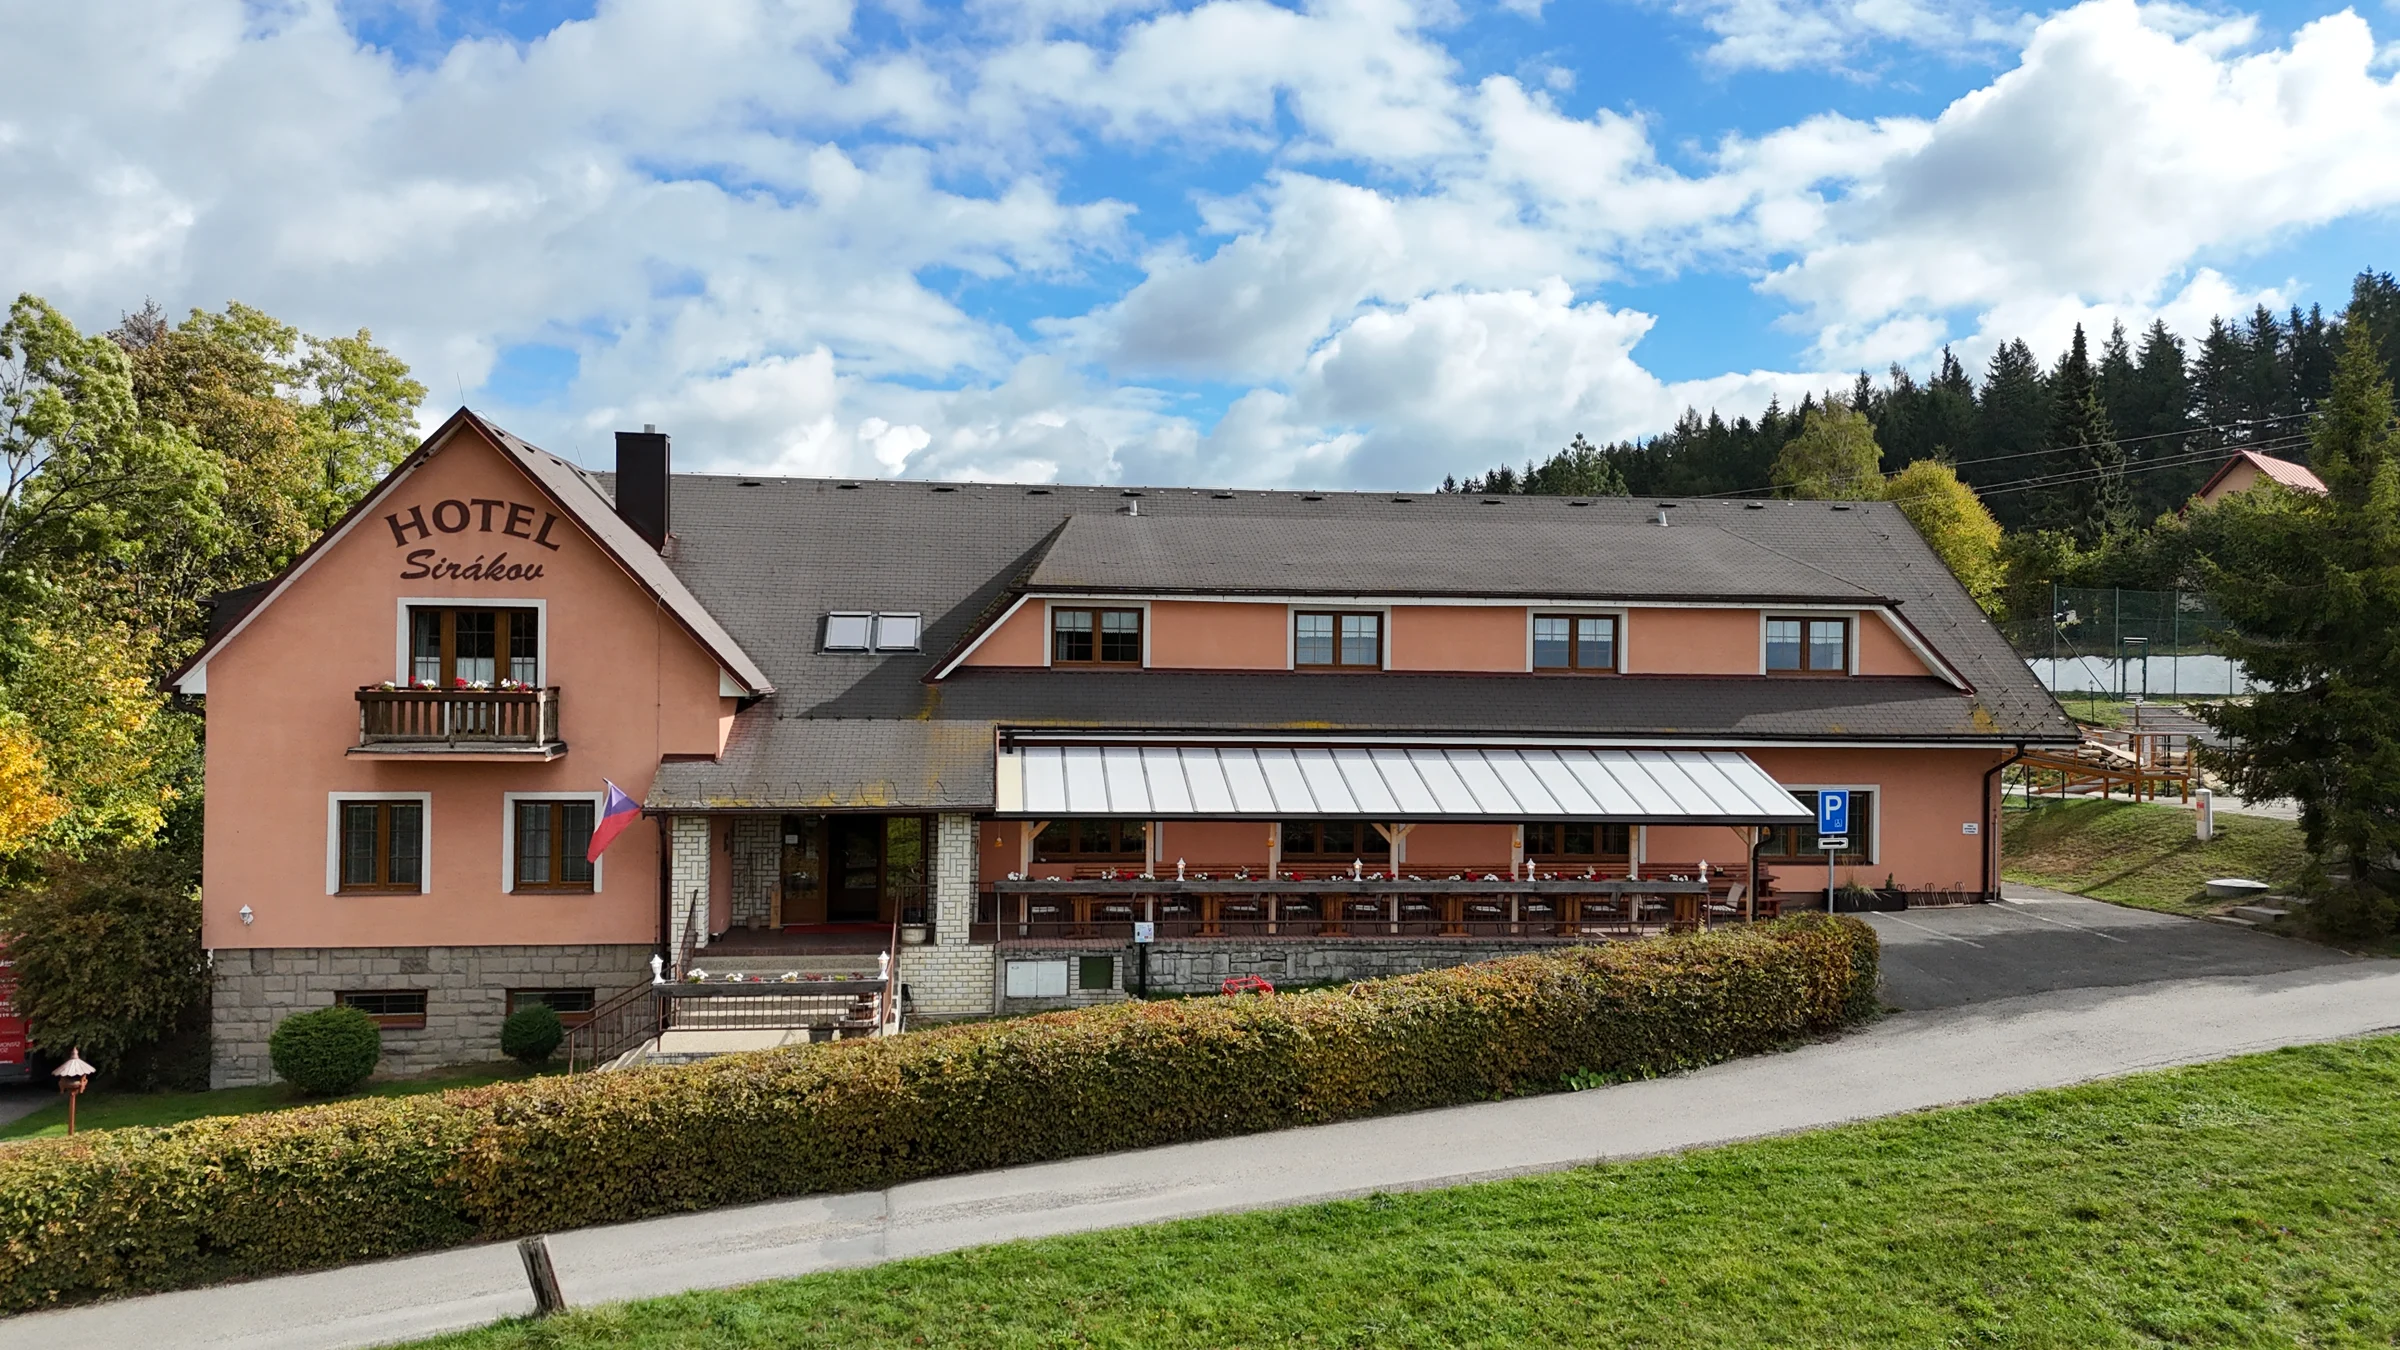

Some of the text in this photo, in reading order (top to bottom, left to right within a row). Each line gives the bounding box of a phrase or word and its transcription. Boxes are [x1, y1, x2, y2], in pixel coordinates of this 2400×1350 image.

[384, 498, 561, 551] HOTEL
[400, 549, 544, 581] Sirákov
[1825, 795, 1842, 820] P
